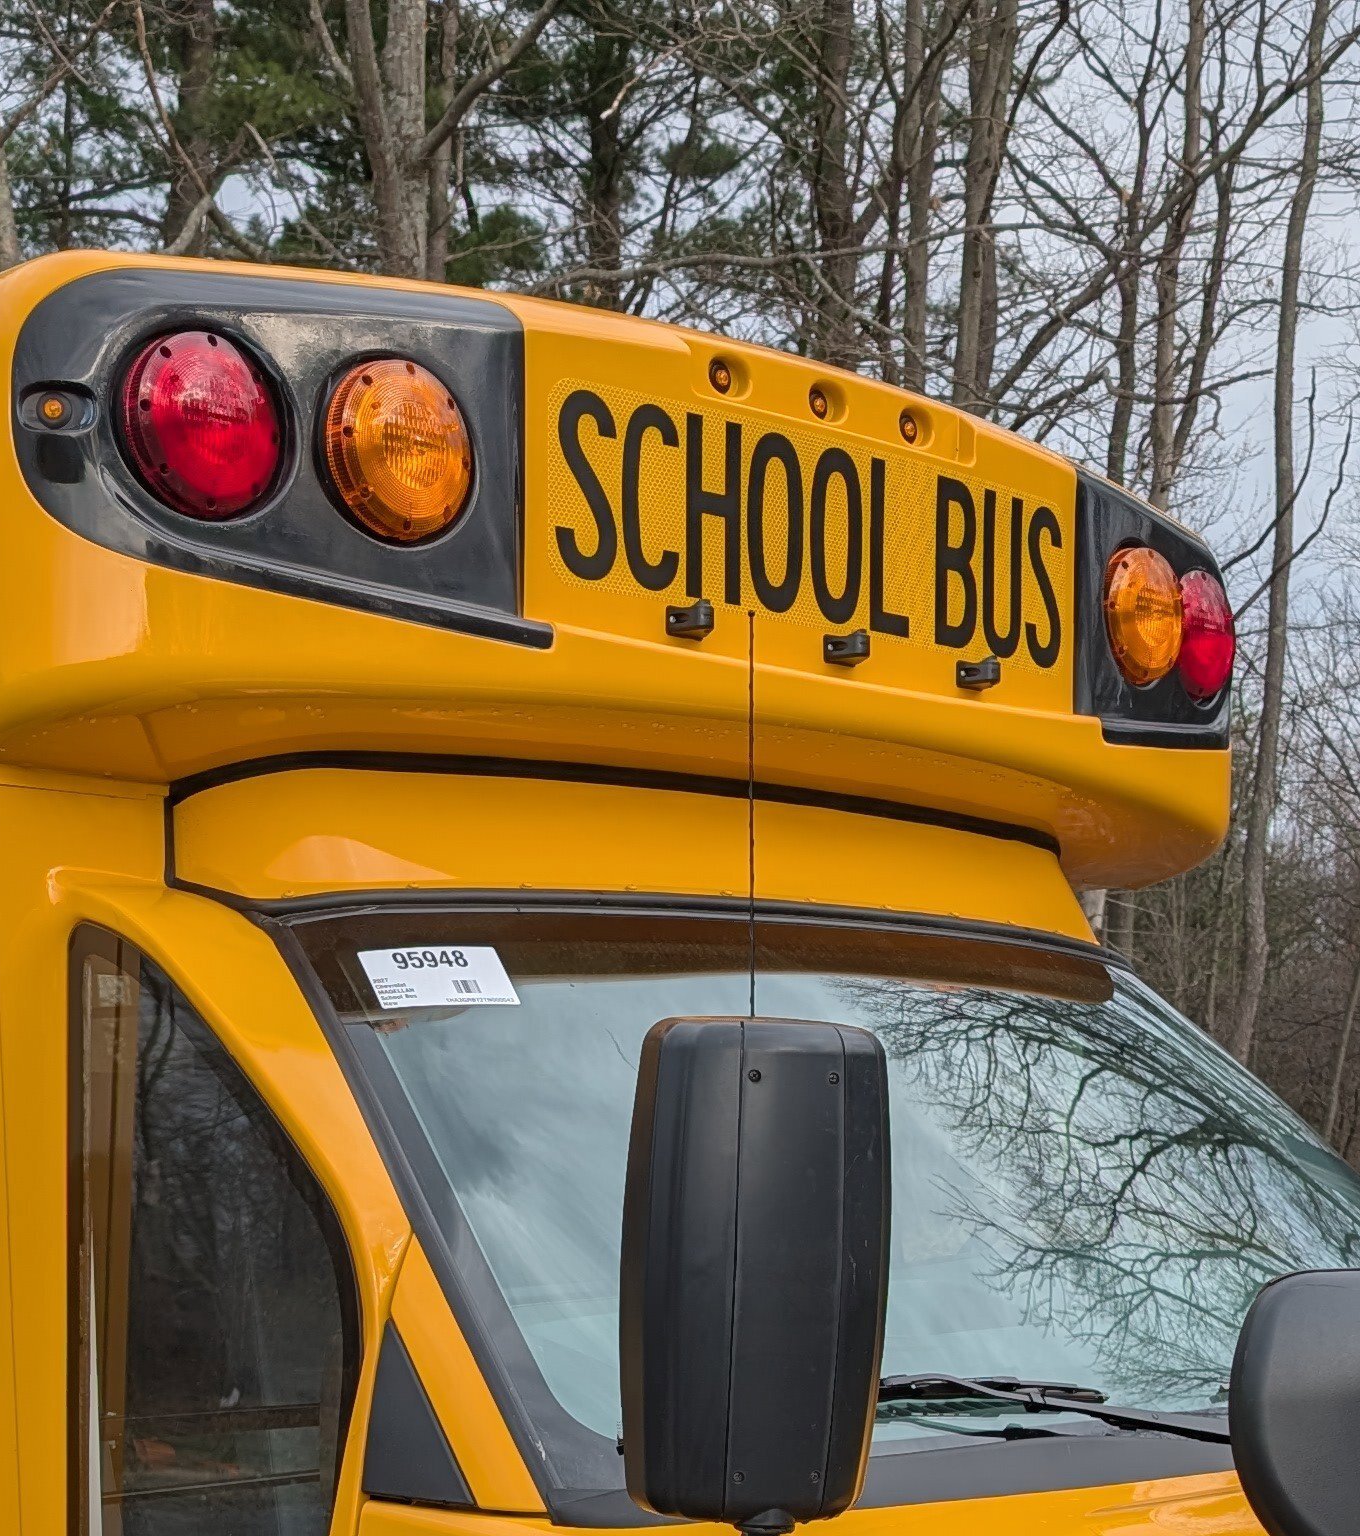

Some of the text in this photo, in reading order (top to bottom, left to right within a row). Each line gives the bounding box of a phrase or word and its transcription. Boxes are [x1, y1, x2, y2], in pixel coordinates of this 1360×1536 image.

[555, 389, 1063, 669] SCHOOL BUS
[391, 950, 469, 970] 95948
